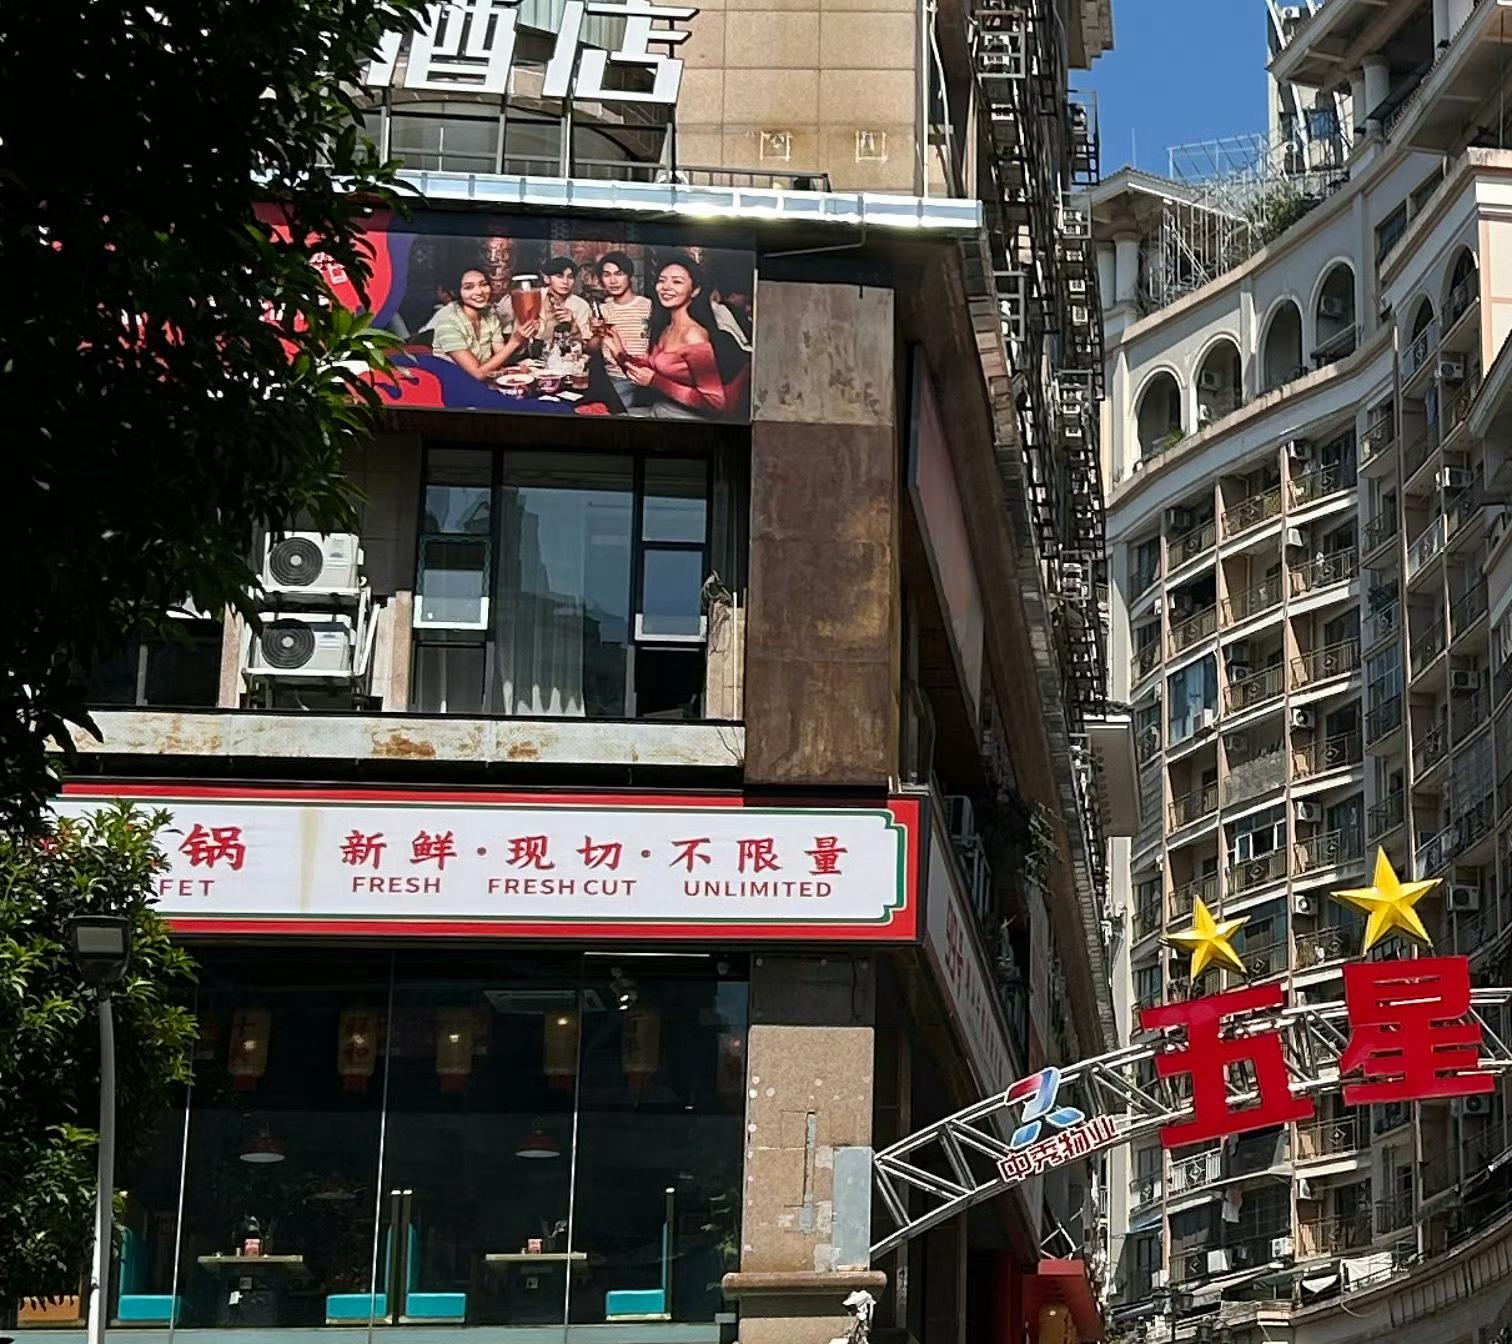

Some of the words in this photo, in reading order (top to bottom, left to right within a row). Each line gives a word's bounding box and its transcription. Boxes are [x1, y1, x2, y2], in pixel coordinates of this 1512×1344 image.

[179, 823, 247, 871] 锅
[352, 876, 442, 895] FRESH
[488, 878, 576, 896] FRESH
[584, 878, 637, 897] CUT
[684, 880, 833, 899] UNLIMITED
